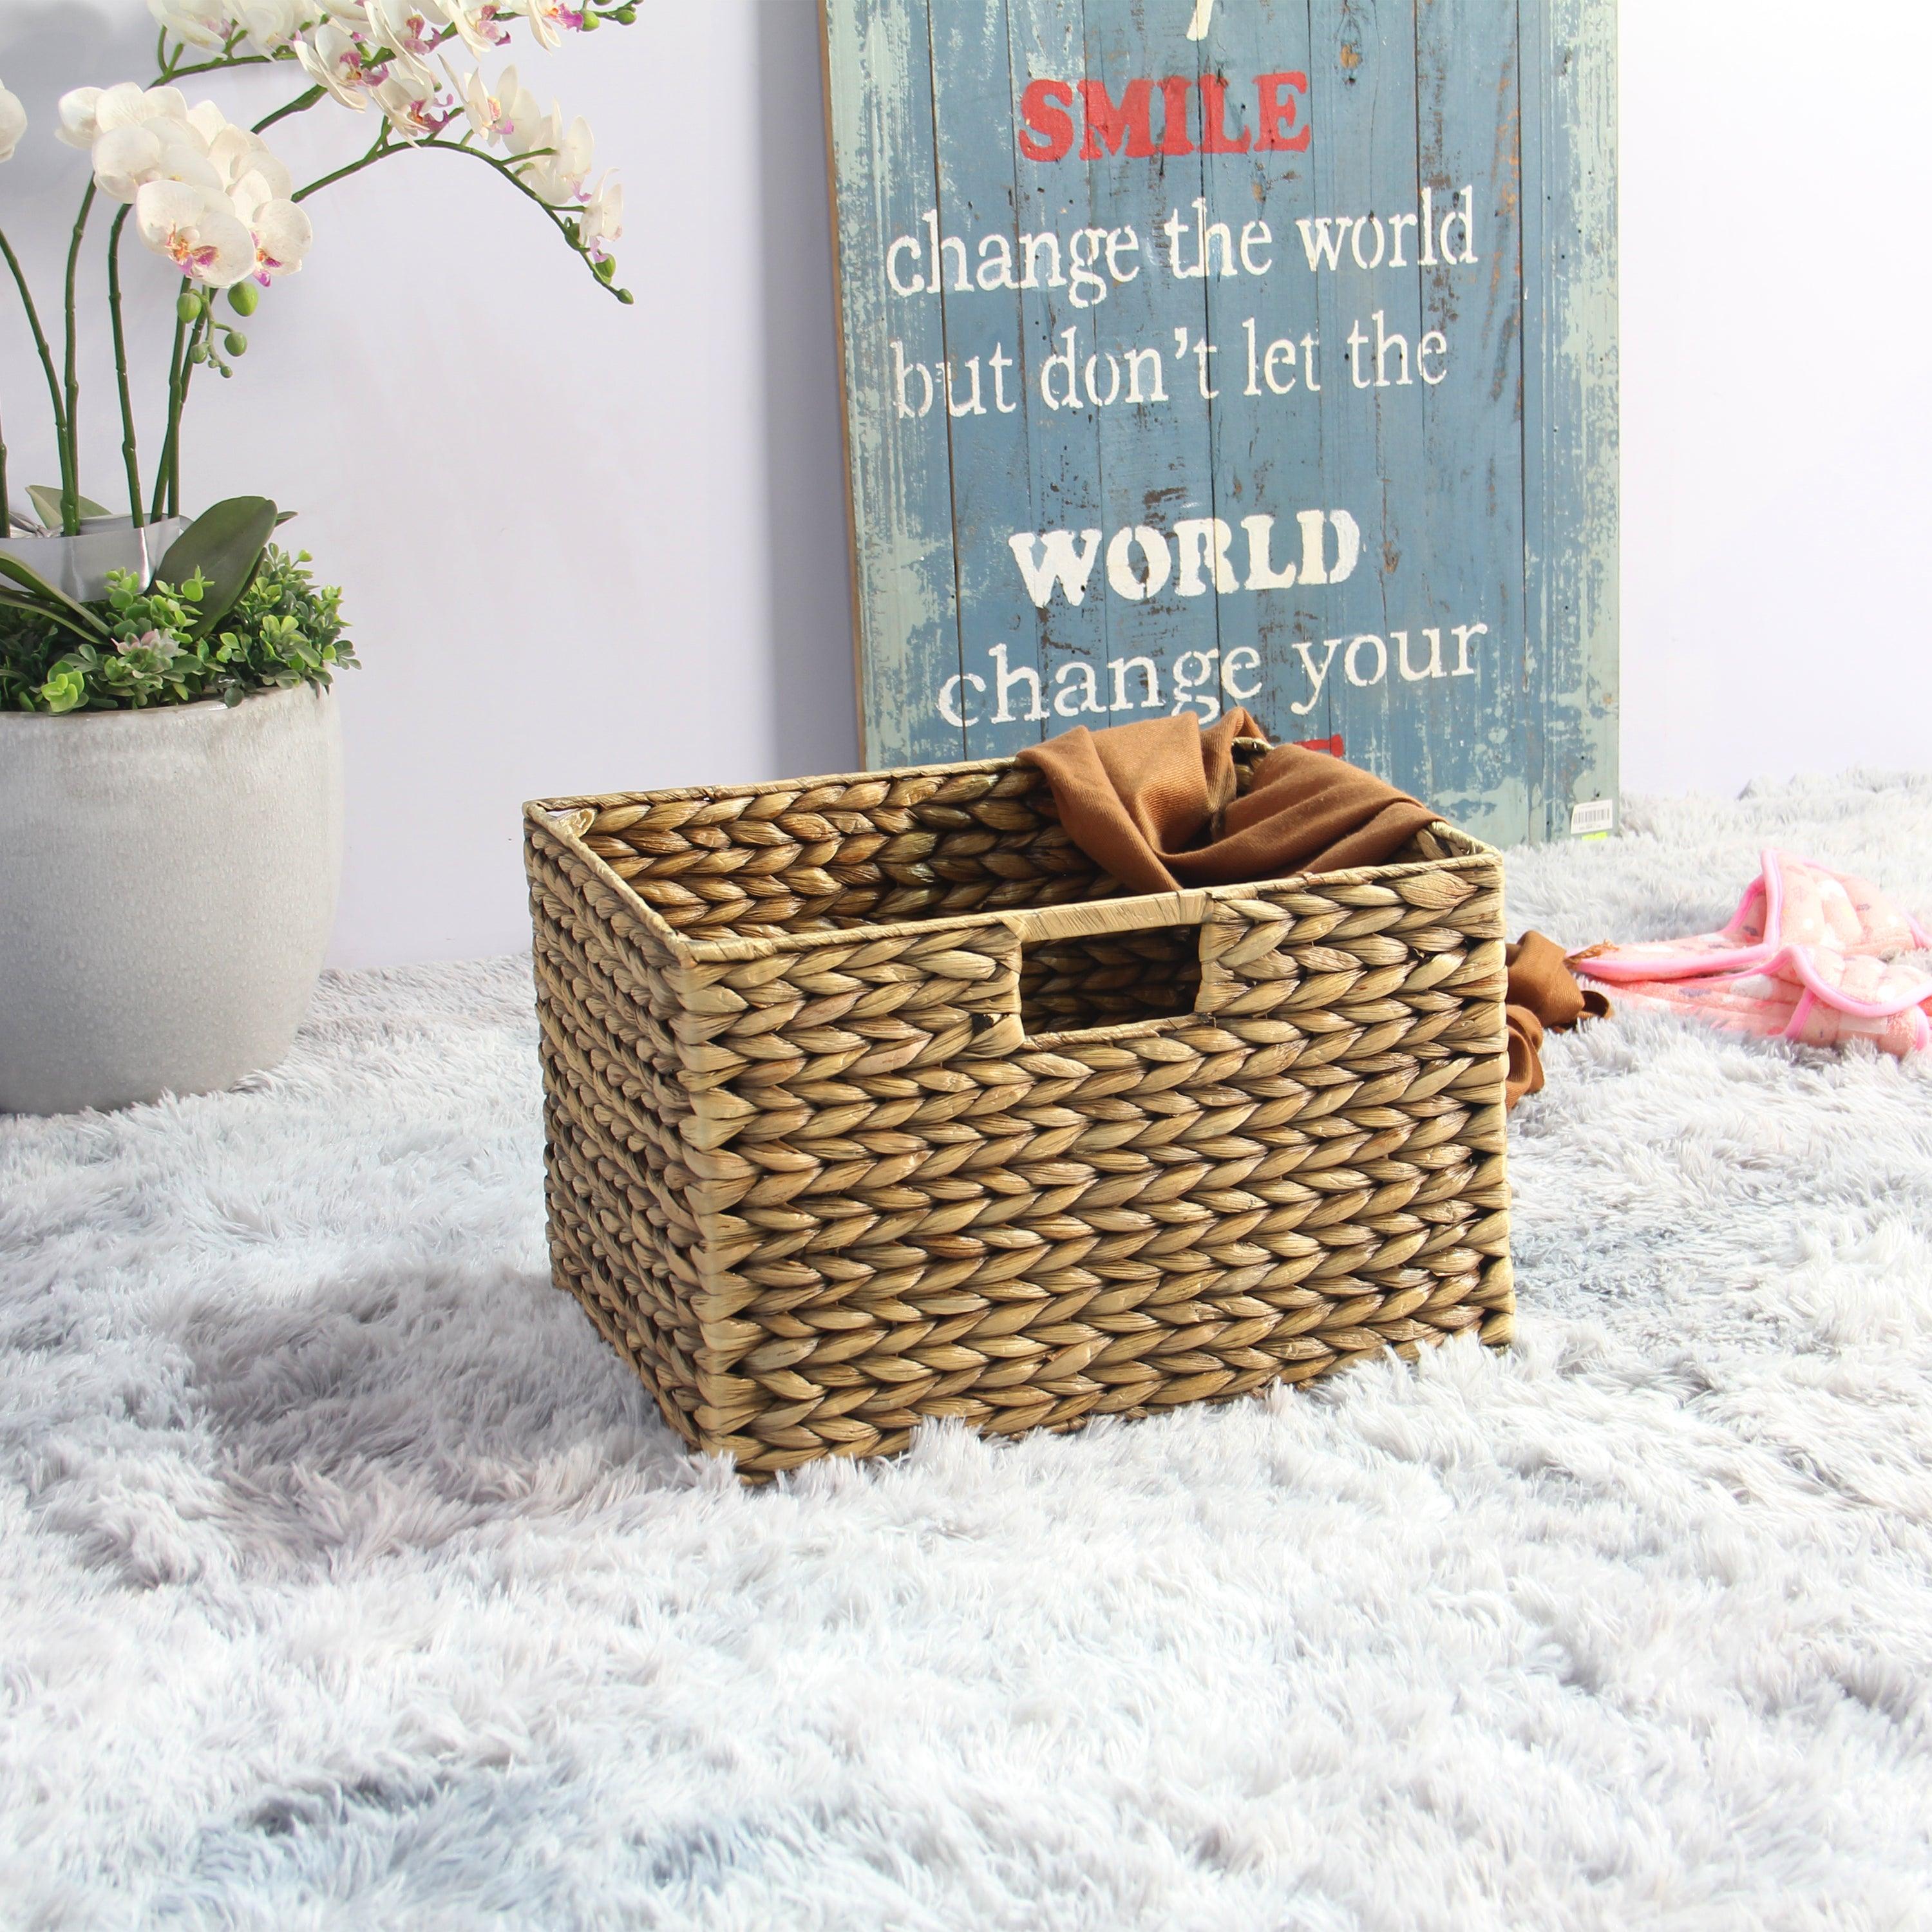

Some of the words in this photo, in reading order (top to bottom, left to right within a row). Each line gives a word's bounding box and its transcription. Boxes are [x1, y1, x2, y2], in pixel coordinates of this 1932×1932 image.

[1018, 71, 1311, 161] SMILE
[887, 209, 1139, 308] change
[1166, 198, 1273, 279] the
[1296, 185, 1478, 271] world
[891, 340, 1016, 417] but
[1040, 326, 1218, 410] don't
[1242, 317, 1320, 397] let
[1348, 310, 1447, 387] the
[1009, 509, 1359, 609] WORLD
[936, 643, 1262, 727] change
[1290, 623, 1487, 715] your
